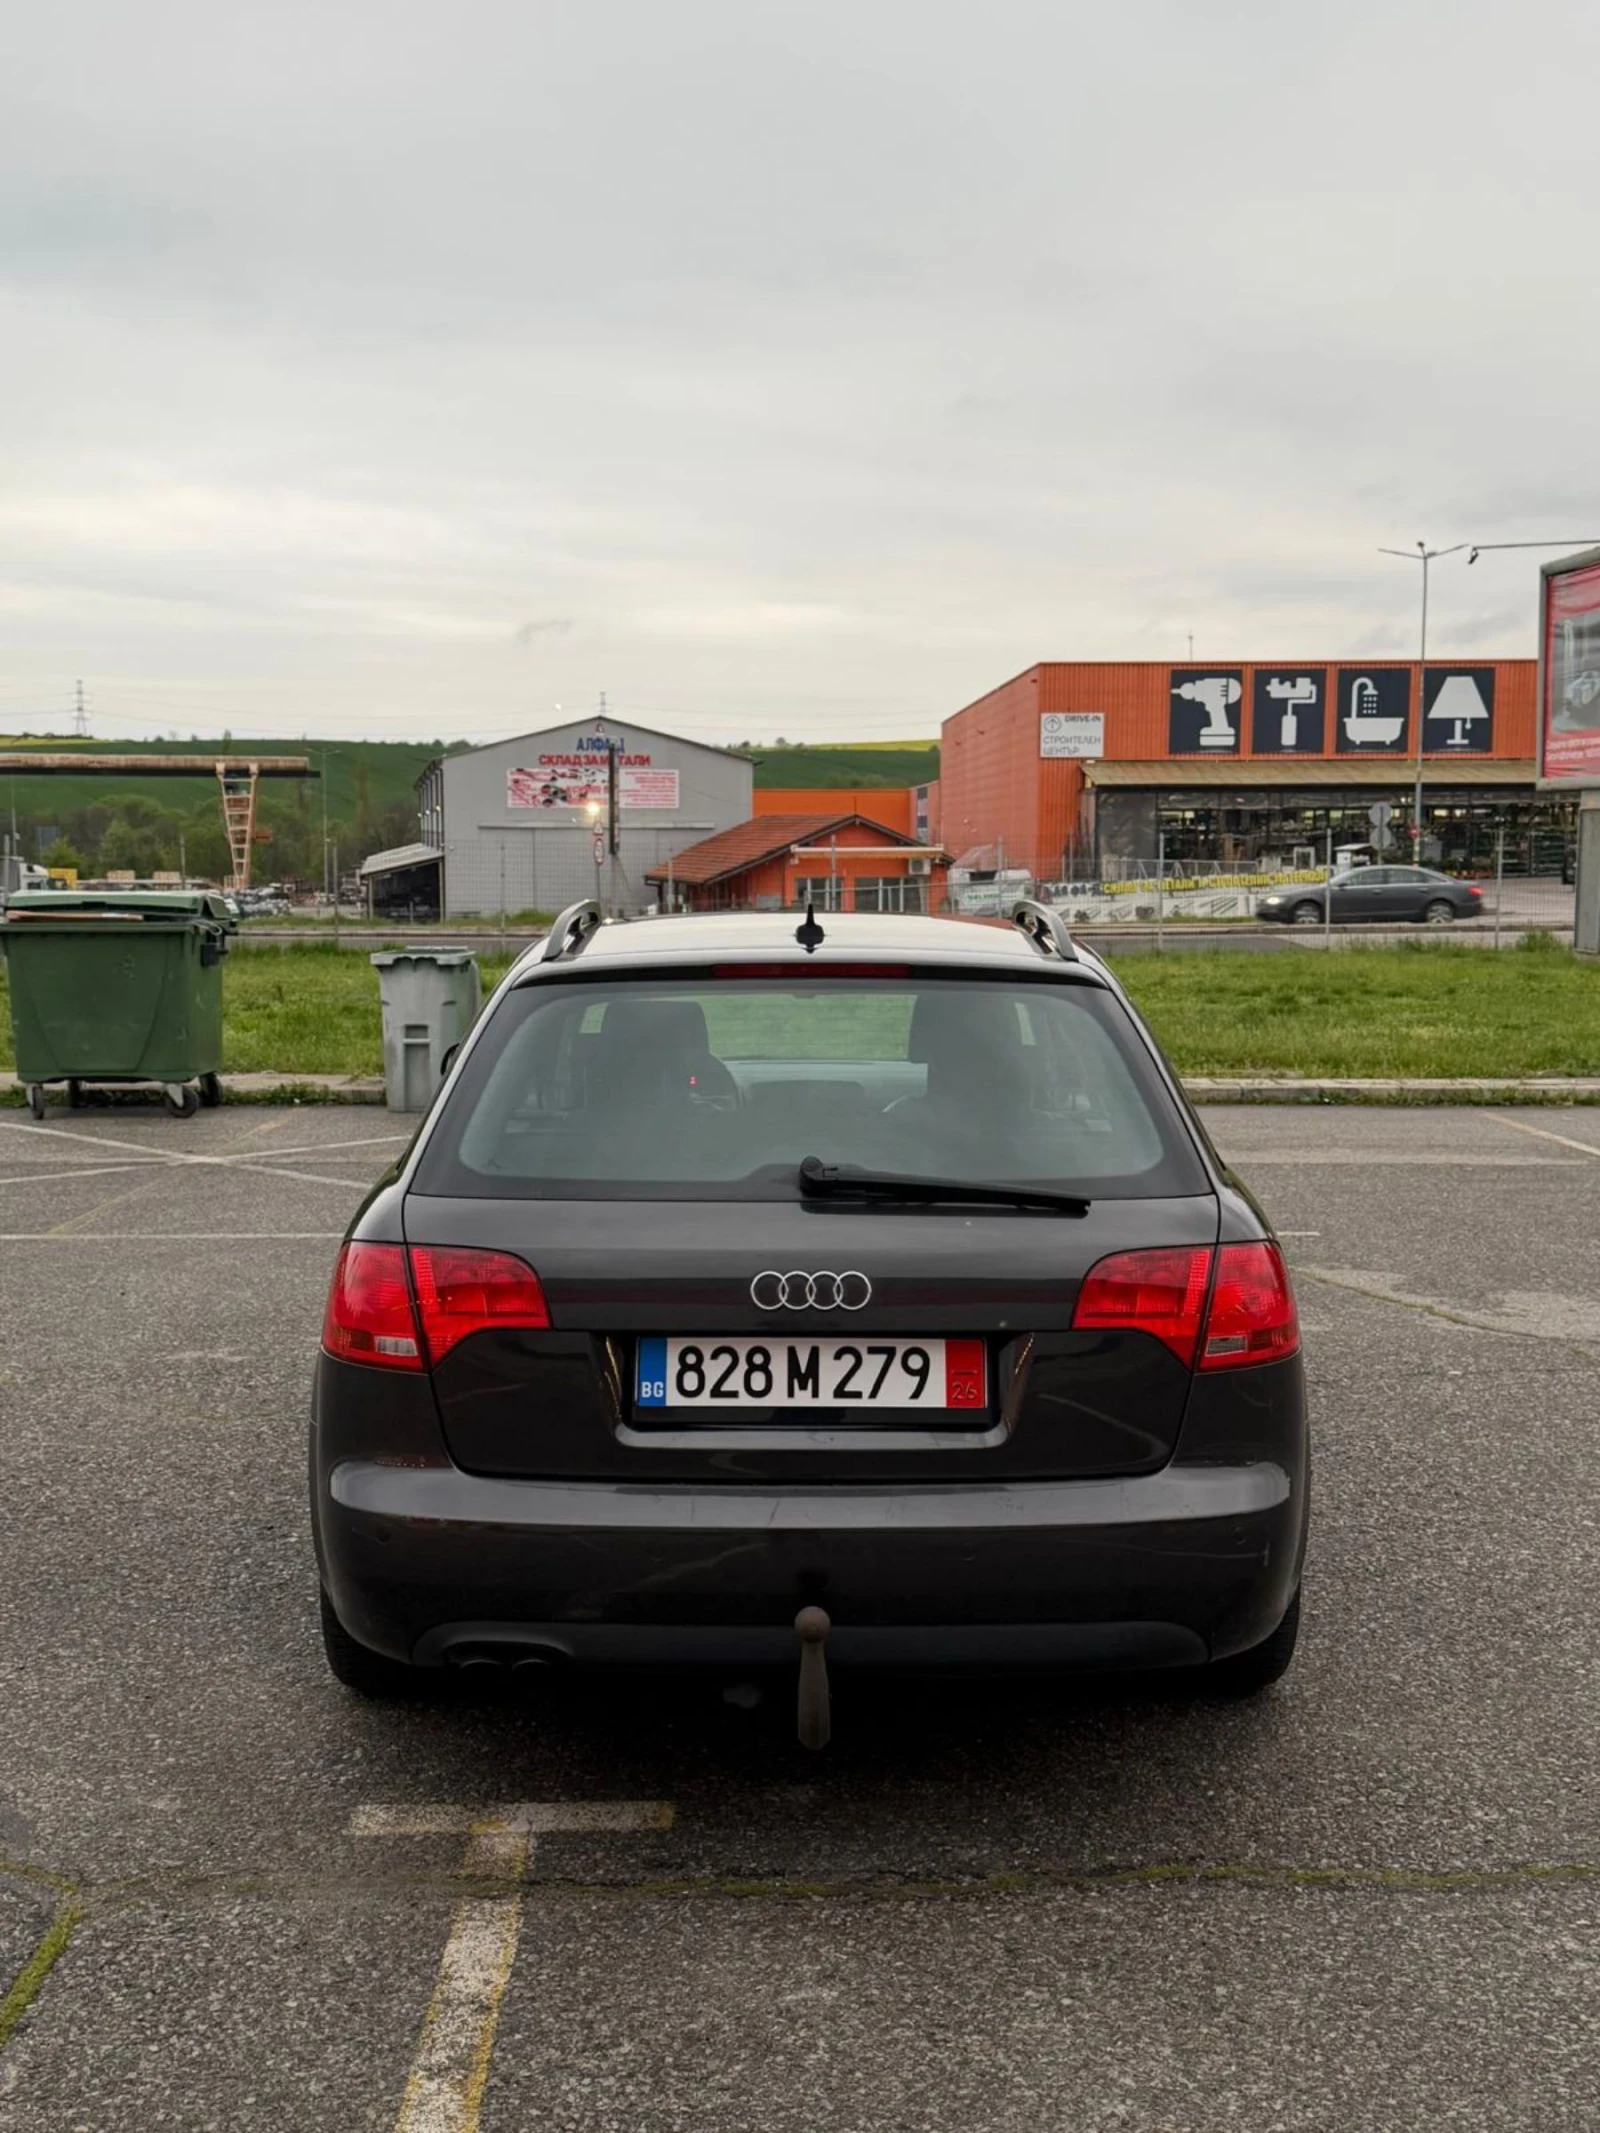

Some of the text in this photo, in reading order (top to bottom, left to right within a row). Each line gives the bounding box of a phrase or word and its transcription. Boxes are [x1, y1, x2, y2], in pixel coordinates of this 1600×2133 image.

[1043, 735, 1101, 745] СТРОИТЕЛЕН
[538, 754, 651, 767] СКЛАД ЗА МТАЛИ
[675, 1346, 931, 1399] 828 M 279
[641, 1381, 664, 1398] BG
[952, 1381, 978, 1400] 26
